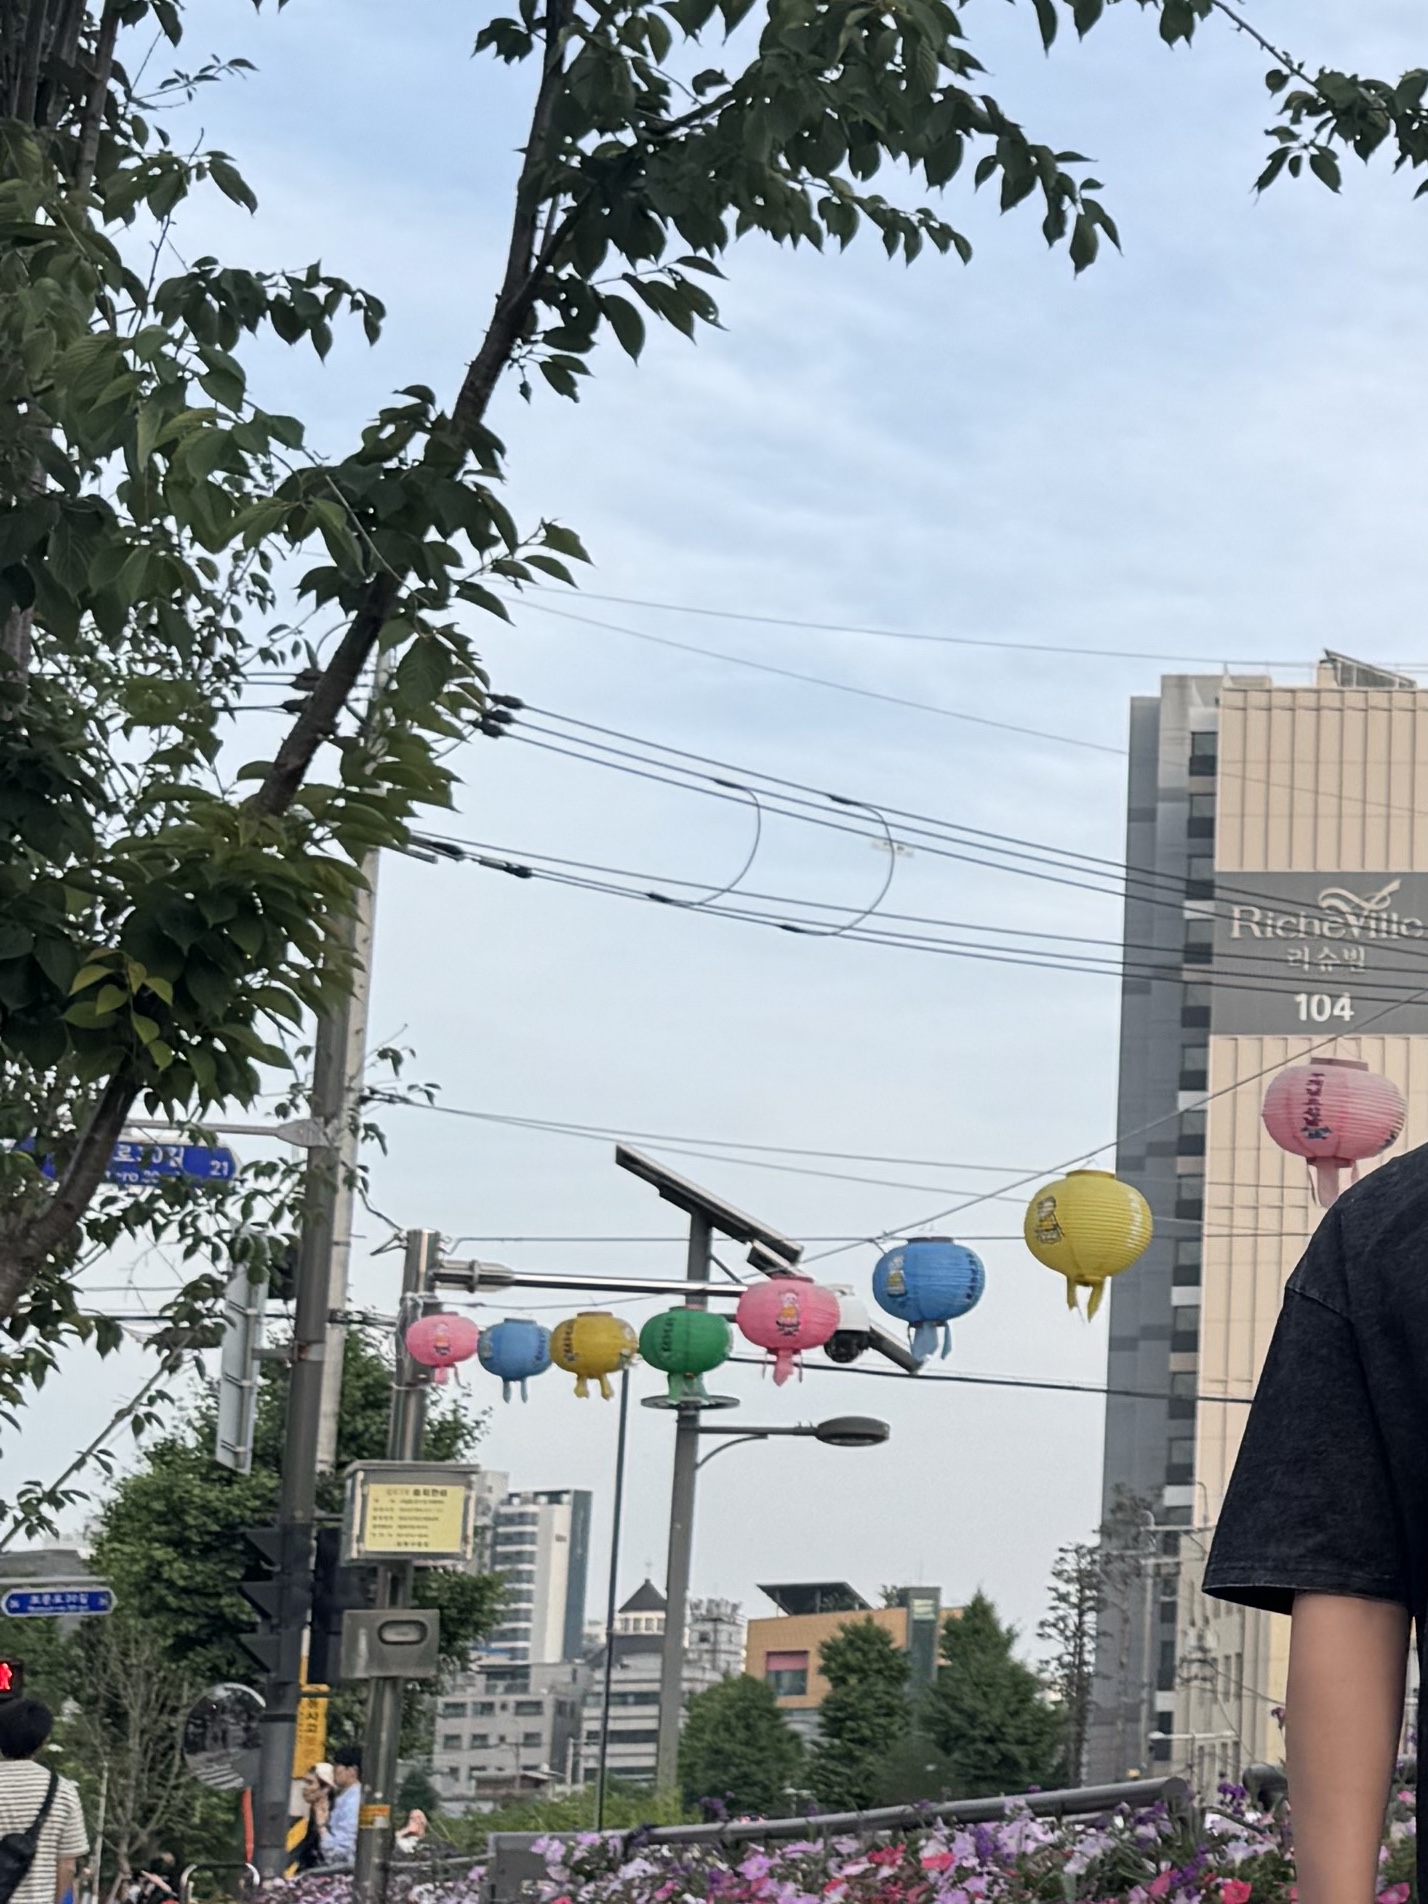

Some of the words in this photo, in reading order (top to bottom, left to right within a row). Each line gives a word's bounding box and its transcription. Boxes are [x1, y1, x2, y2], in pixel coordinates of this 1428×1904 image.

[1230, 891, 1425, 940] RicheVille
[1294, 992, 1355, 1023] 104
[210, 1159, 229, 1177] 21
